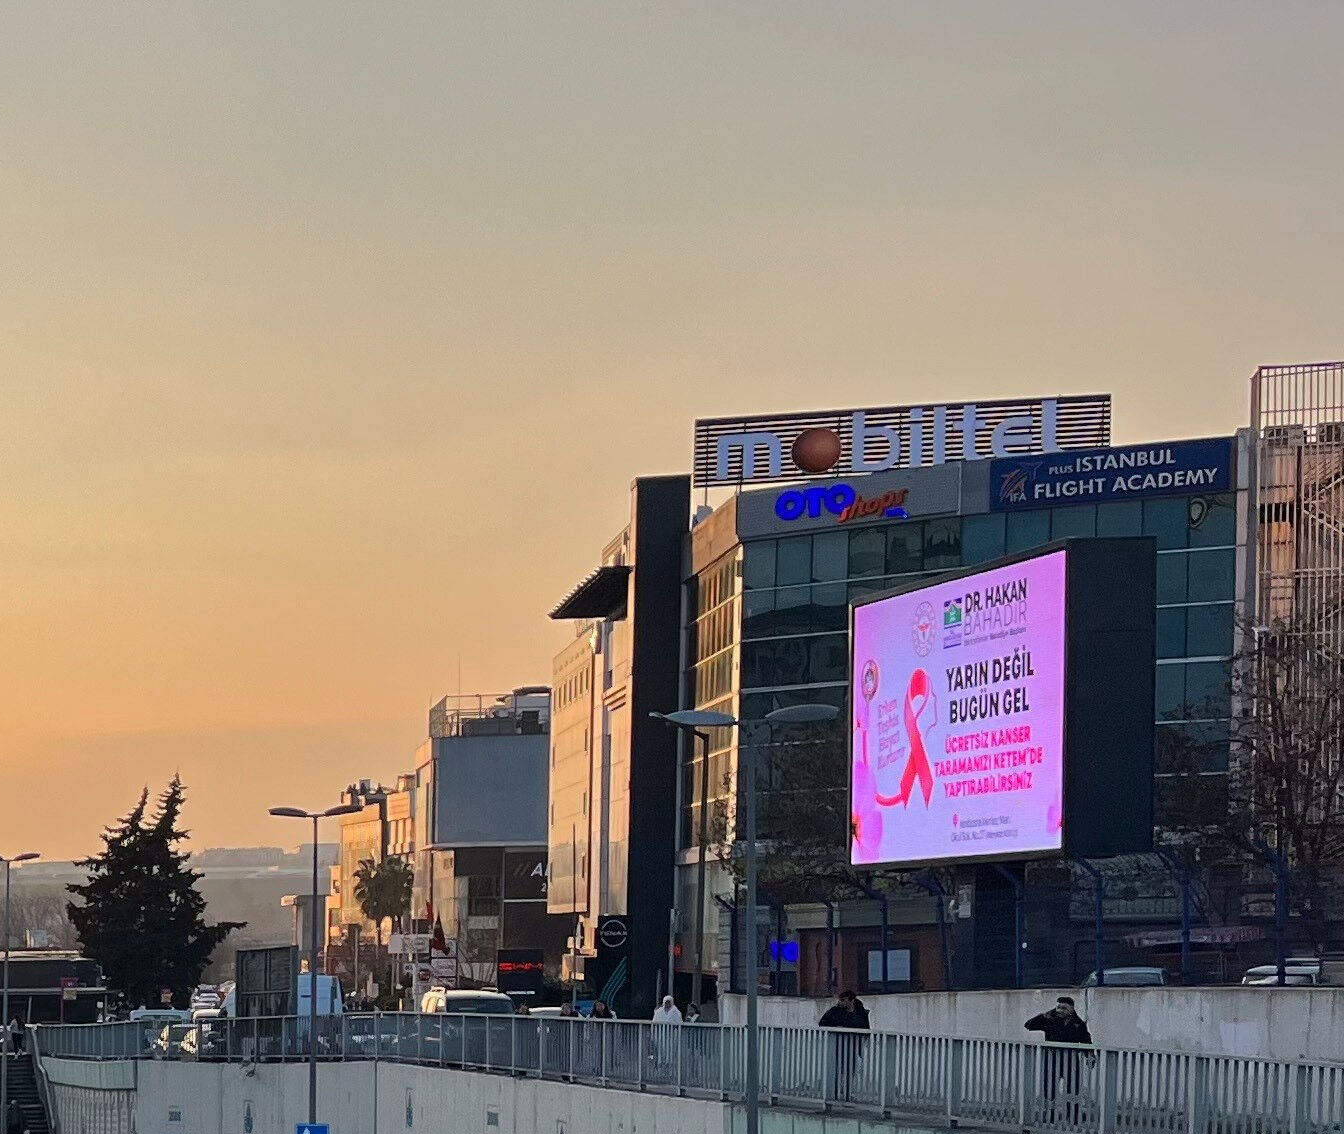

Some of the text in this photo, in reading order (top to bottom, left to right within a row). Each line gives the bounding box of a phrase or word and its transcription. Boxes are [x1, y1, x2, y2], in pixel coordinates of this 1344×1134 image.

[1048, 449, 1176, 475] PLUS ISTANBUL
[1034, 467, 1218, 499] FLIGHT ACADEMY
[775, 484, 856, 521] OTO
[985, 577, 1027, 609] HAKAN
[946, 644, 1035, 693] YARIN DEĞİL
[949, 686, 1030, 724] BUGÜN GEL
[991, 725, 1031, 748] KANSER
